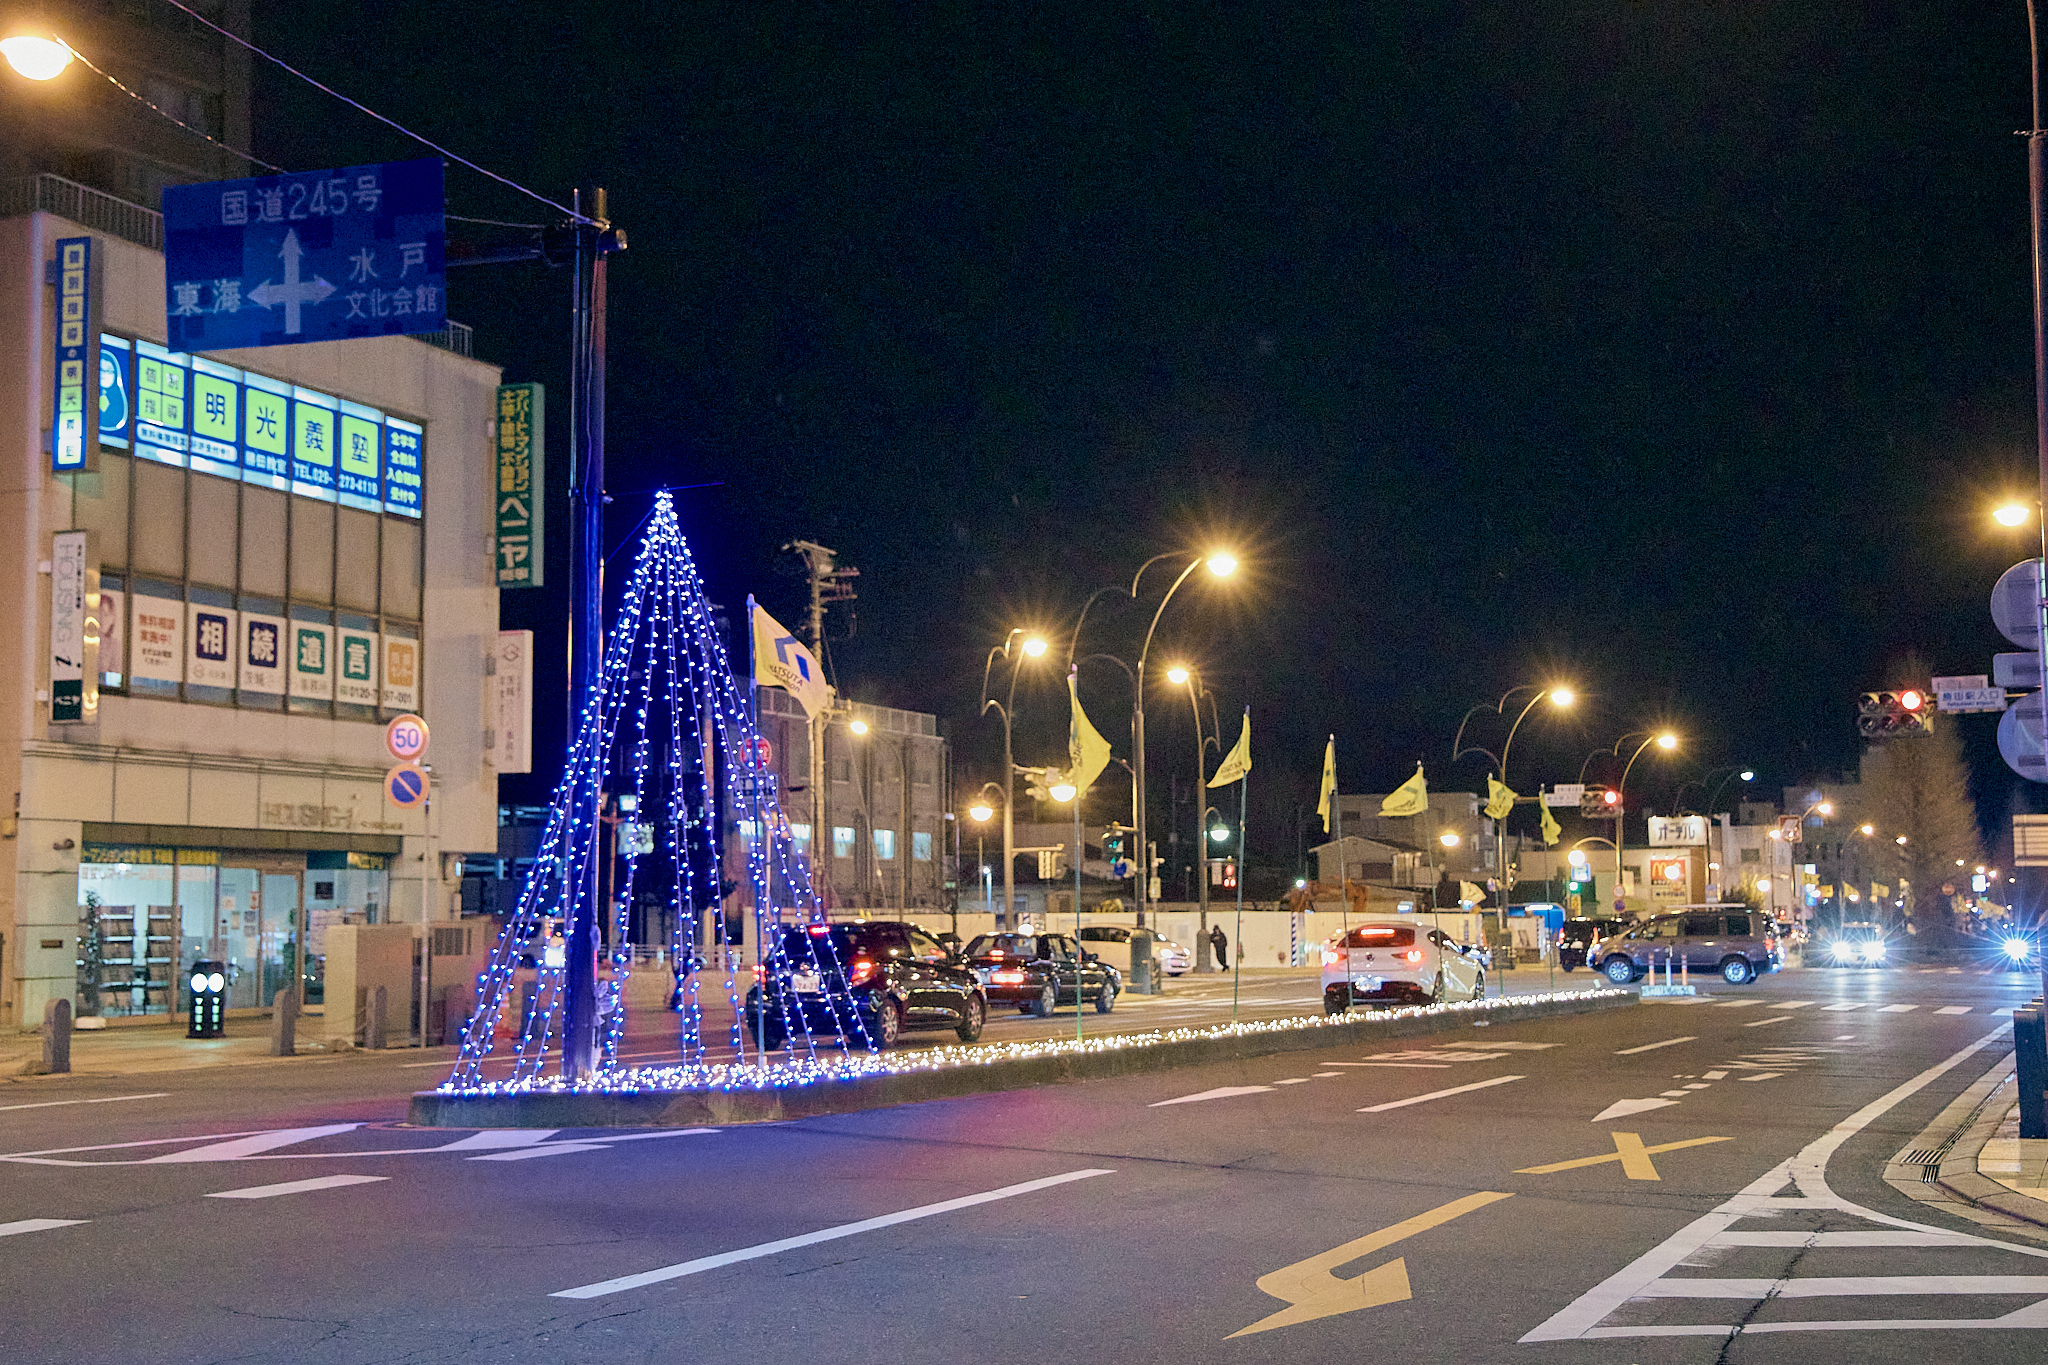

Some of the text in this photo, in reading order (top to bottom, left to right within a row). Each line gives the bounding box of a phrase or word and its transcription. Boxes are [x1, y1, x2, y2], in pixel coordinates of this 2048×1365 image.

[221, 174, 383, 226] 国道245号
[350, 242, 427, 283] 水戸
[173, 278, 242, 317] 東海
[345, 284, 438, 319] 文化会館
[205, 391, 370, 465] 明光義塾
[395, 728, 419, 748] 50
